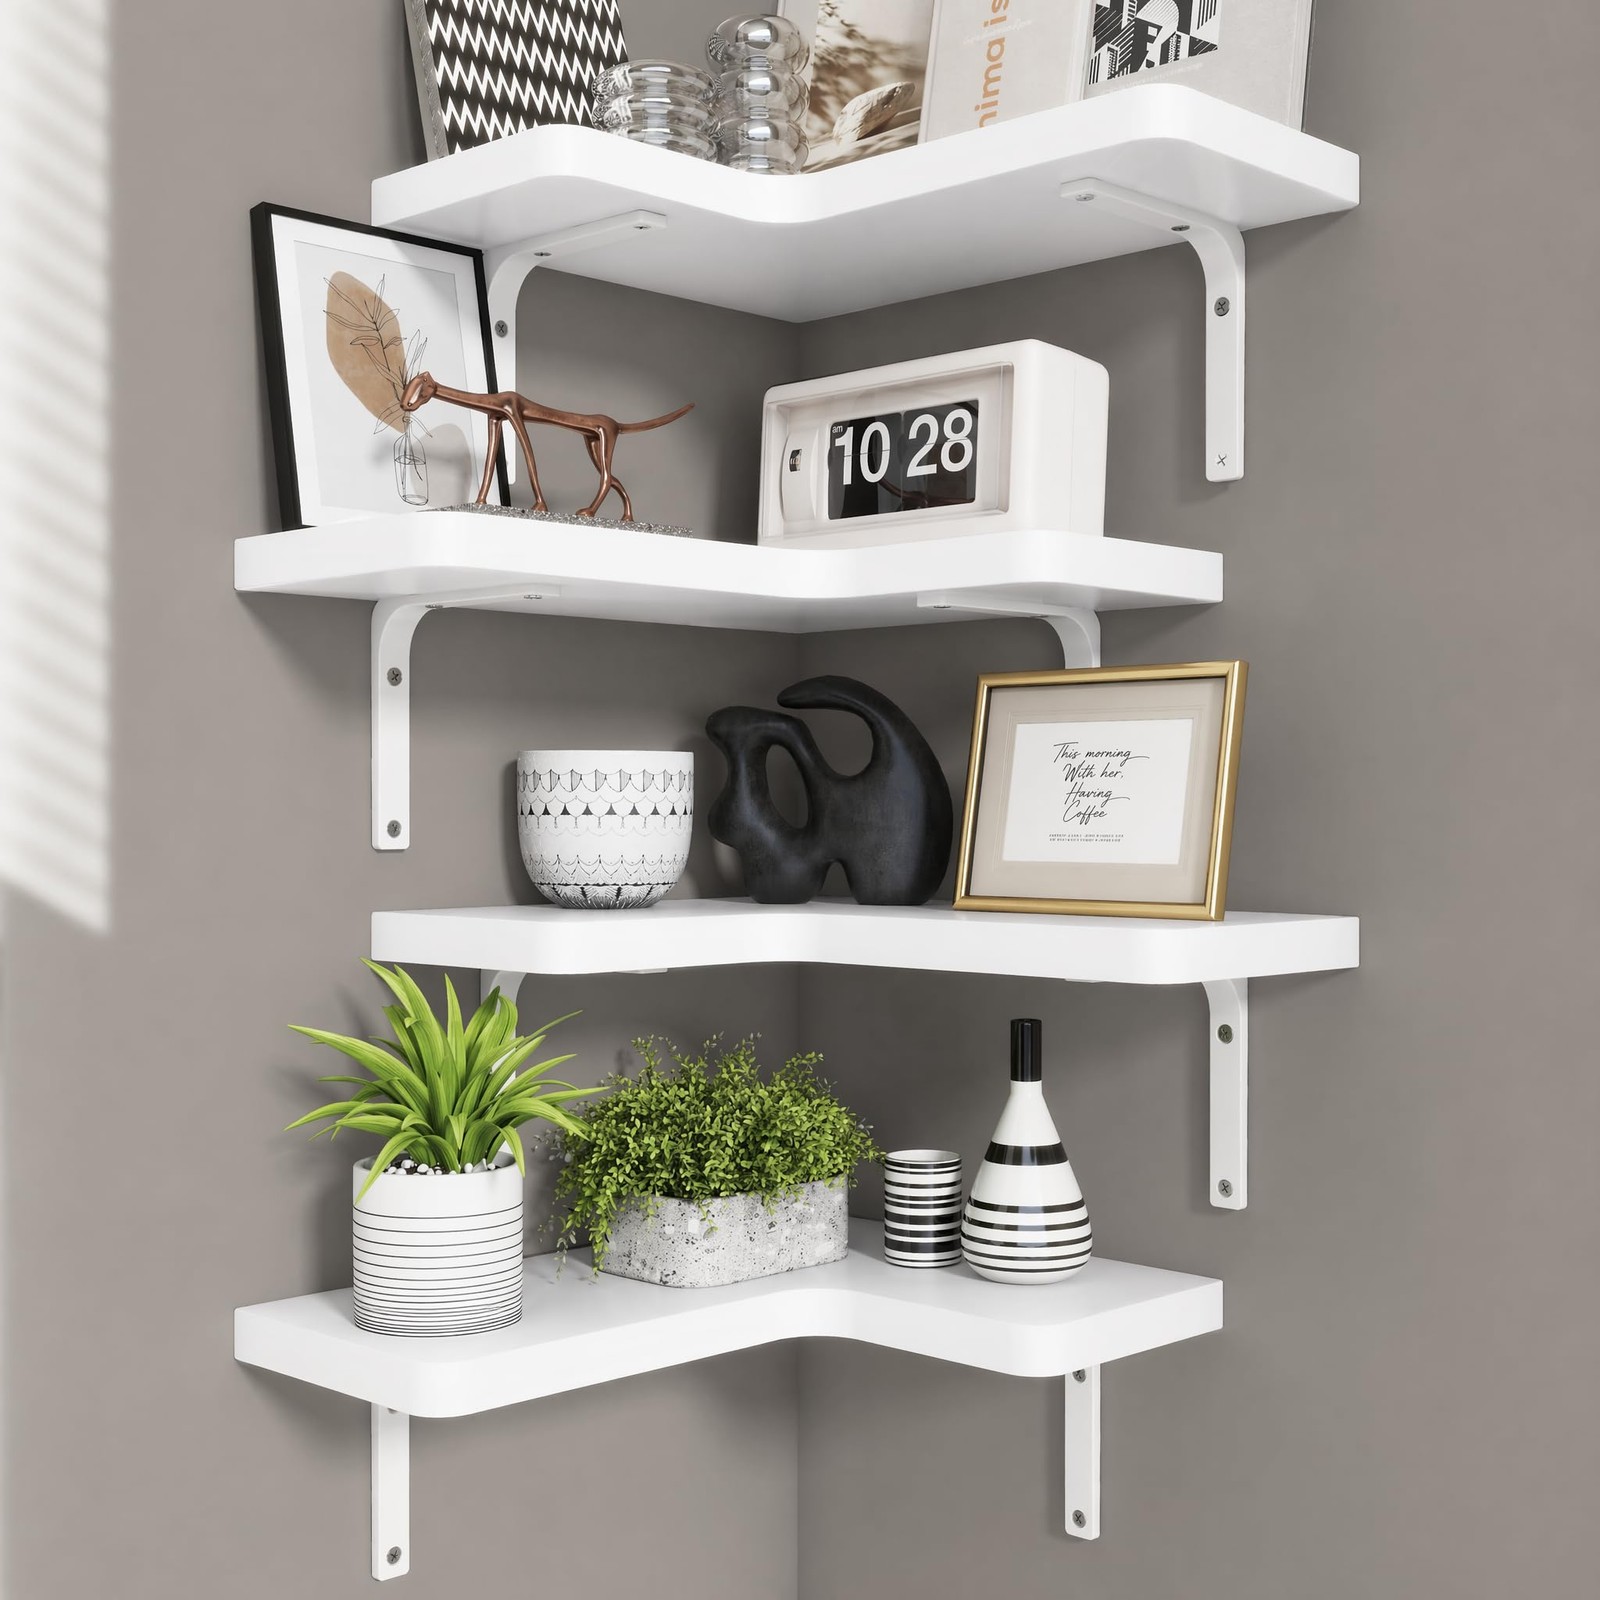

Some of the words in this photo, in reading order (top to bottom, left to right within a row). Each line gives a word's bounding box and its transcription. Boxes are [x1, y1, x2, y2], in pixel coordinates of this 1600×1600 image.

[832, 425, 843, 434] am
[834, 421, 891, 486] 10
[906, 408, 973, 478] 28
[1053, 741, 1081, 763] This
[1084, 748, 1150, 767] morning
[1062, 760, 1096, 782] With
[1064, 781, 1131, 808] Having
[1062, 799, 1108, 825] Coffee
